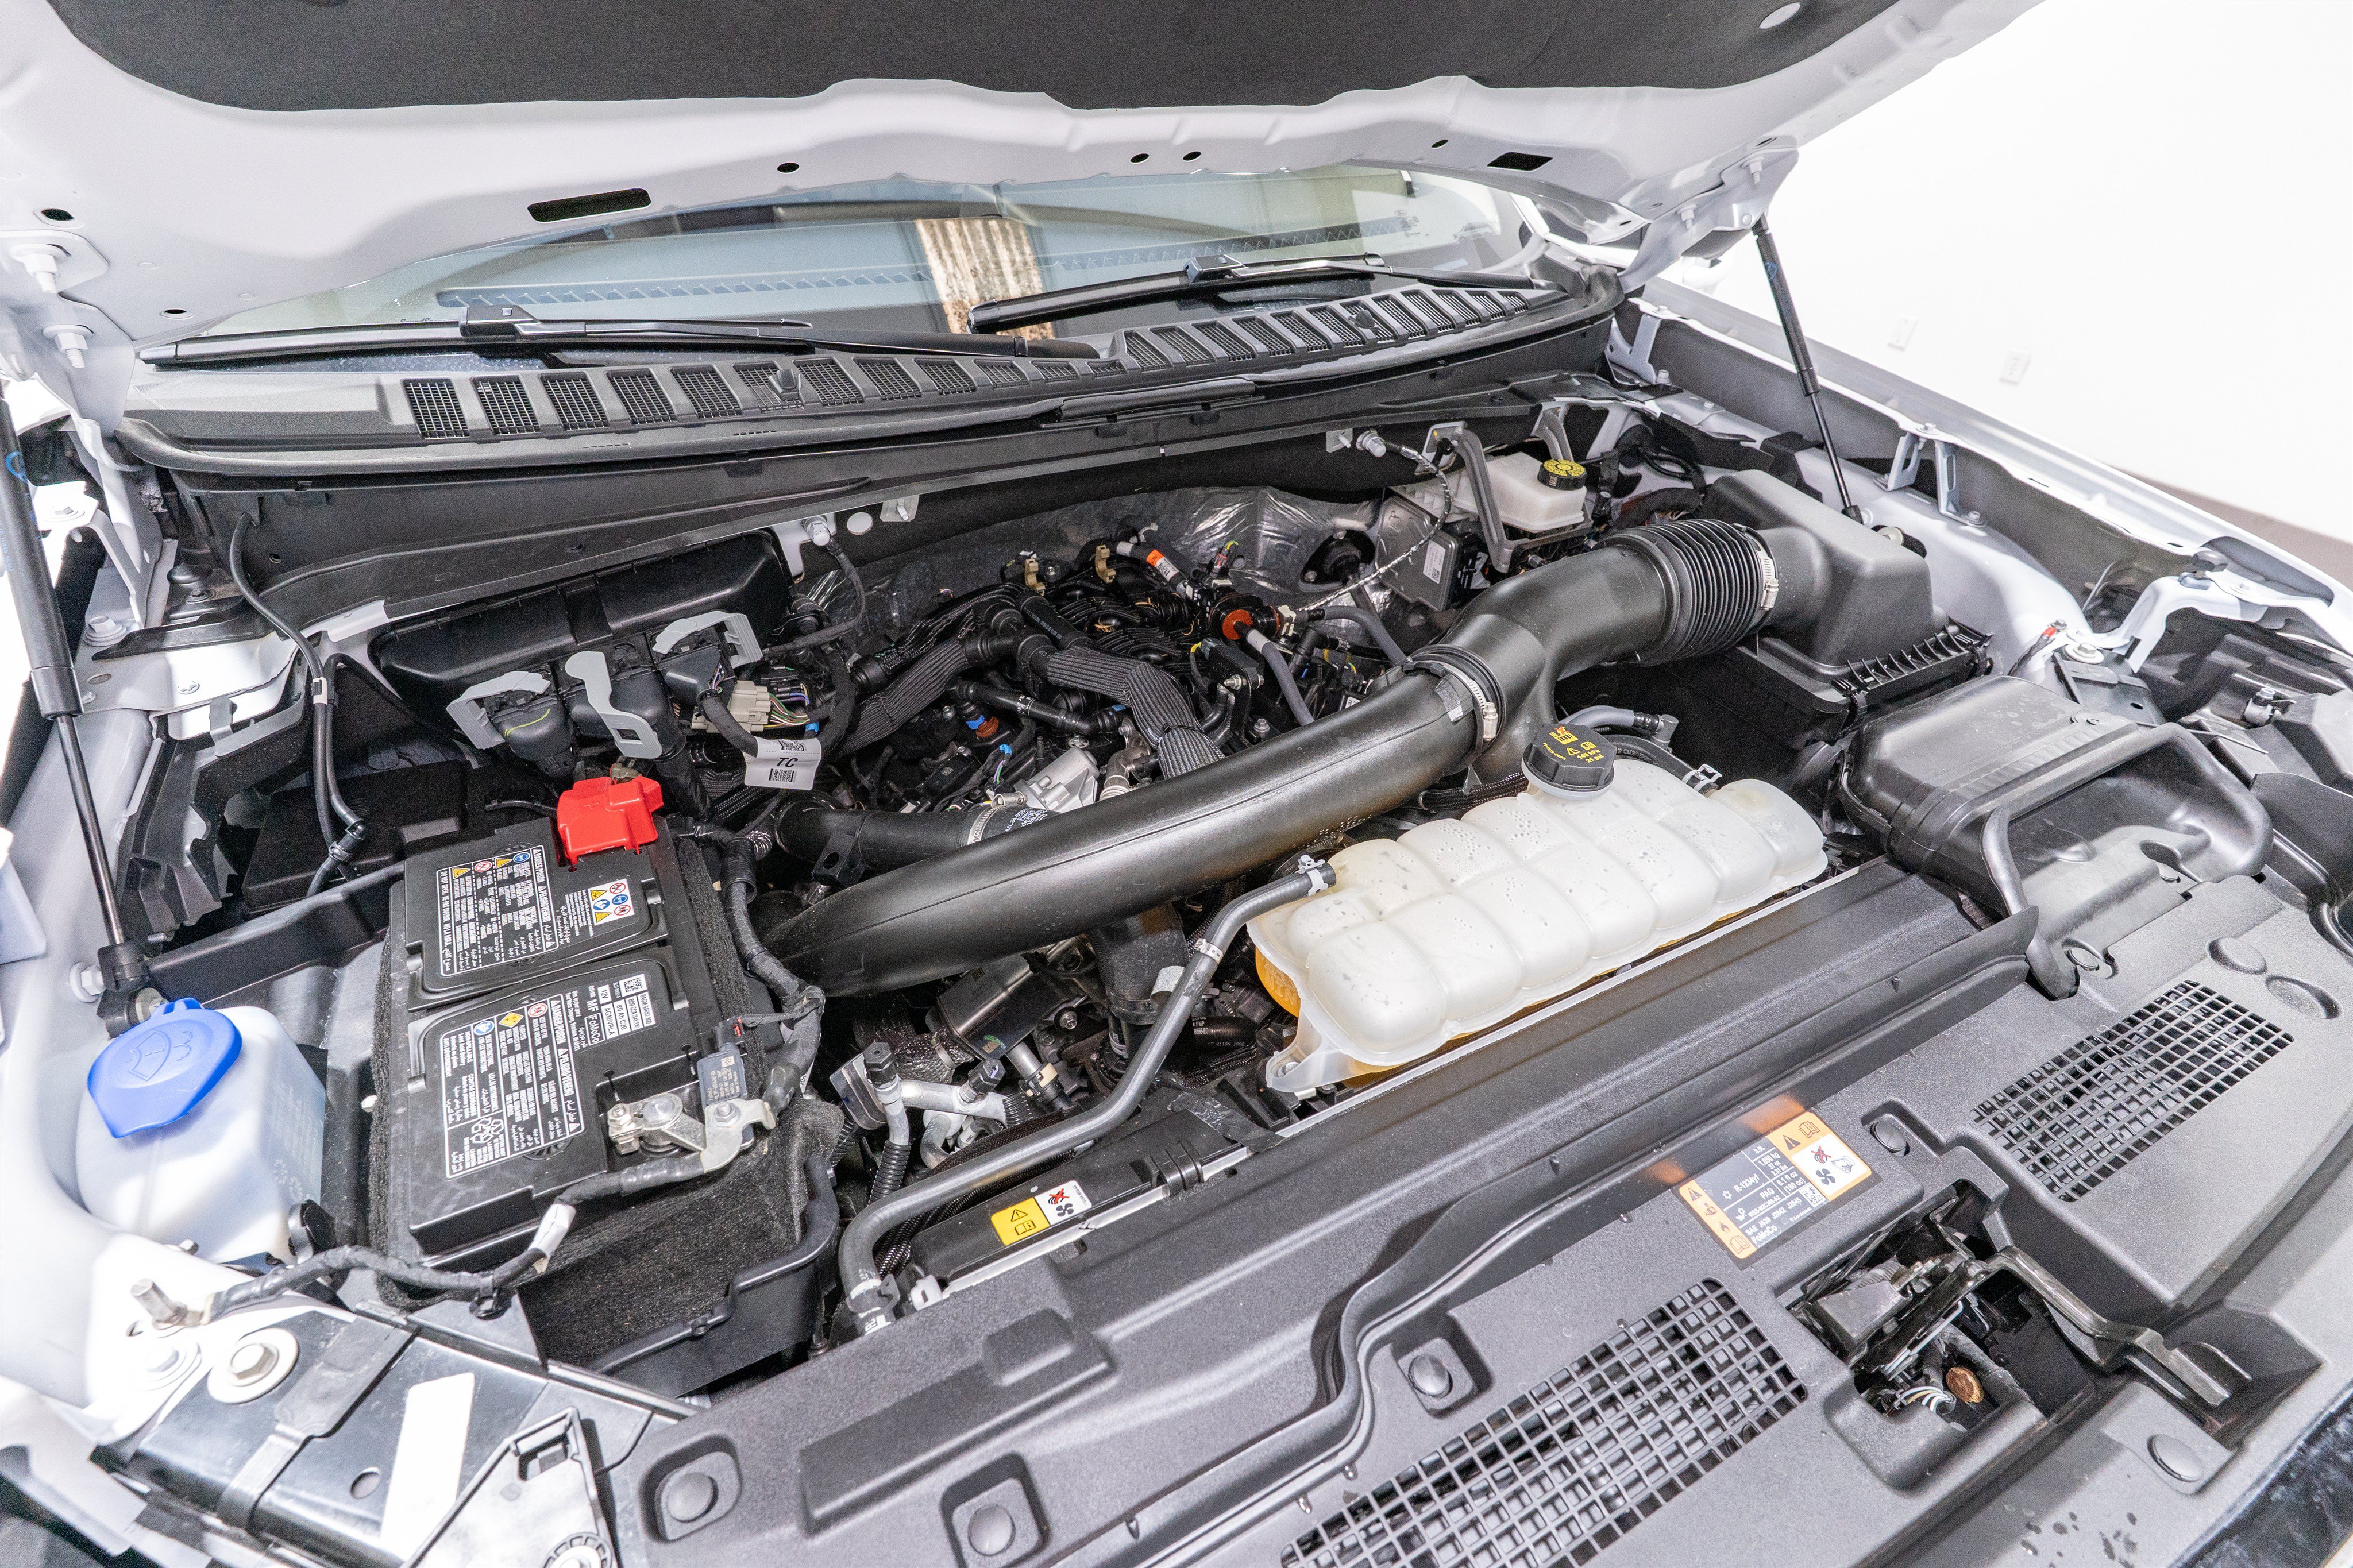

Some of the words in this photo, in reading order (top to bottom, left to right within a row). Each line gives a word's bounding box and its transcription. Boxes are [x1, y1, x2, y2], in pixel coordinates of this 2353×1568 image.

[776, 758, 798, 767] TC
[533, 852, 545, 883] DANGER/POISON
[441, 884, 449, 895] OPEN.
[538, 890, 551, 922] PELIGRO/VENENO
[1266, 971, 1297, 1006] MIN
[586, 998, 599, 1013] MF
[604, 1007, 615, 1036] AGM/VRLA
[618, 1011, 624, 1019] Ah
[551, 1003, 566, 1045] DANGER/POISON
[588, 1014, 601, 1043] FoMoCo
[619, 1019, 627, 1030] C20
[464, 1030, 472, 1063] NON-SPILLABLE
[558, 1053, 574, 1098] PELIGRO/VENENO
[1754, 1145, 1765, 1153] 3.5L
[1758, 1156, 1773, 1166] 1.050
[1770, 1152, 1781, 1160] kg
[1734, 1174, 1761, 1192] R-1234yf
[1777, 1177, 1787, 1185] 6.1
[1783, 1183, 1797, 1193] (180
[1795, 1177, 1806, 1186] cc)
[1760, 1188, 1775, 1199] PAG
[1745, 1225, 1758, 1235] SAE
[1751, 1224, 1777, 1243] FoMoCo
